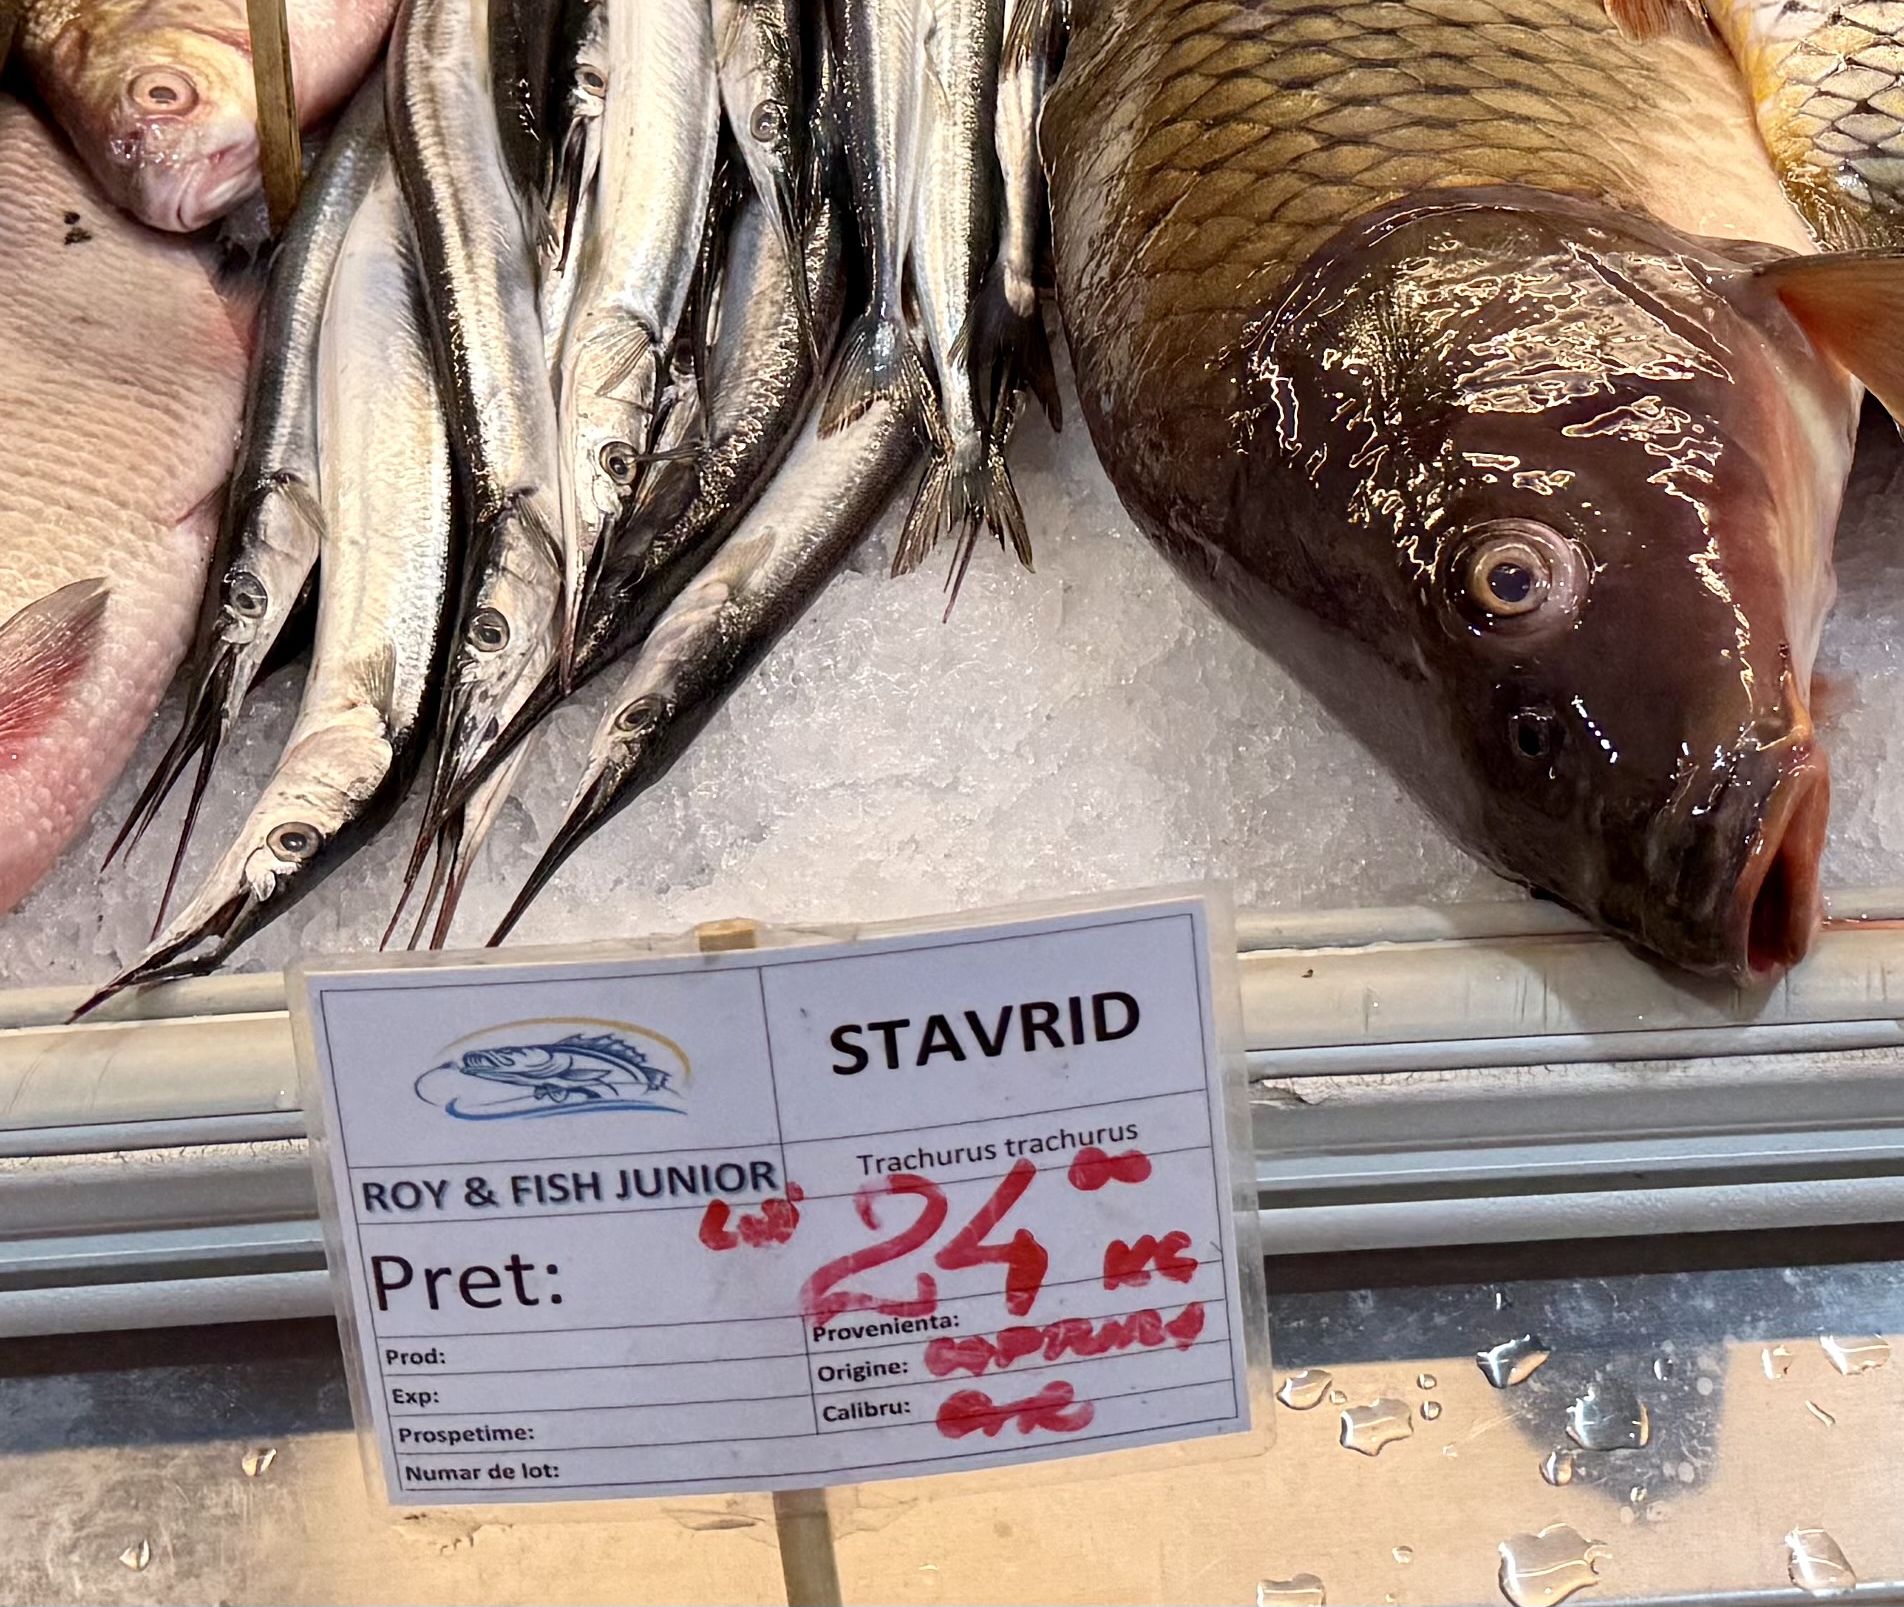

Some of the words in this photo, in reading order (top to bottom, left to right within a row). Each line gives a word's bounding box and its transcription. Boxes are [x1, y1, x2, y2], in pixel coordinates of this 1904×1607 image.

[830, 991, 1140, 1075] STAVRID
[857, 1142, 996, 1176] Trachurus
[1005, 1123, 1138, 1158] trachurus
[362, 1179, 448, 1213] ROY
[465, 1176, 498, 1208] &
[511, 1171, 599, 1205] FISH
[616, 1160, 778, 1198] JUNIOR
[370, 1253, 563, 1311] Pret:
[800, 1158, 1048, 1325] 24
[814, 1312, 959, 1343] Provenienta:
[387, 1347, 446, 1367] Prod:
[818, 1358, 908, 1383] Origine:
[392, 1387, 439, 1407] Exp:
[823, 1399, 910, 1423] Calibru:
[399, 1424, 534, 1447] Prospetime:
[406, 1465, 481, 1483] Numar
[488, 1463, 516, 1480] de
[523, 1462, 559, 1480] lot:
